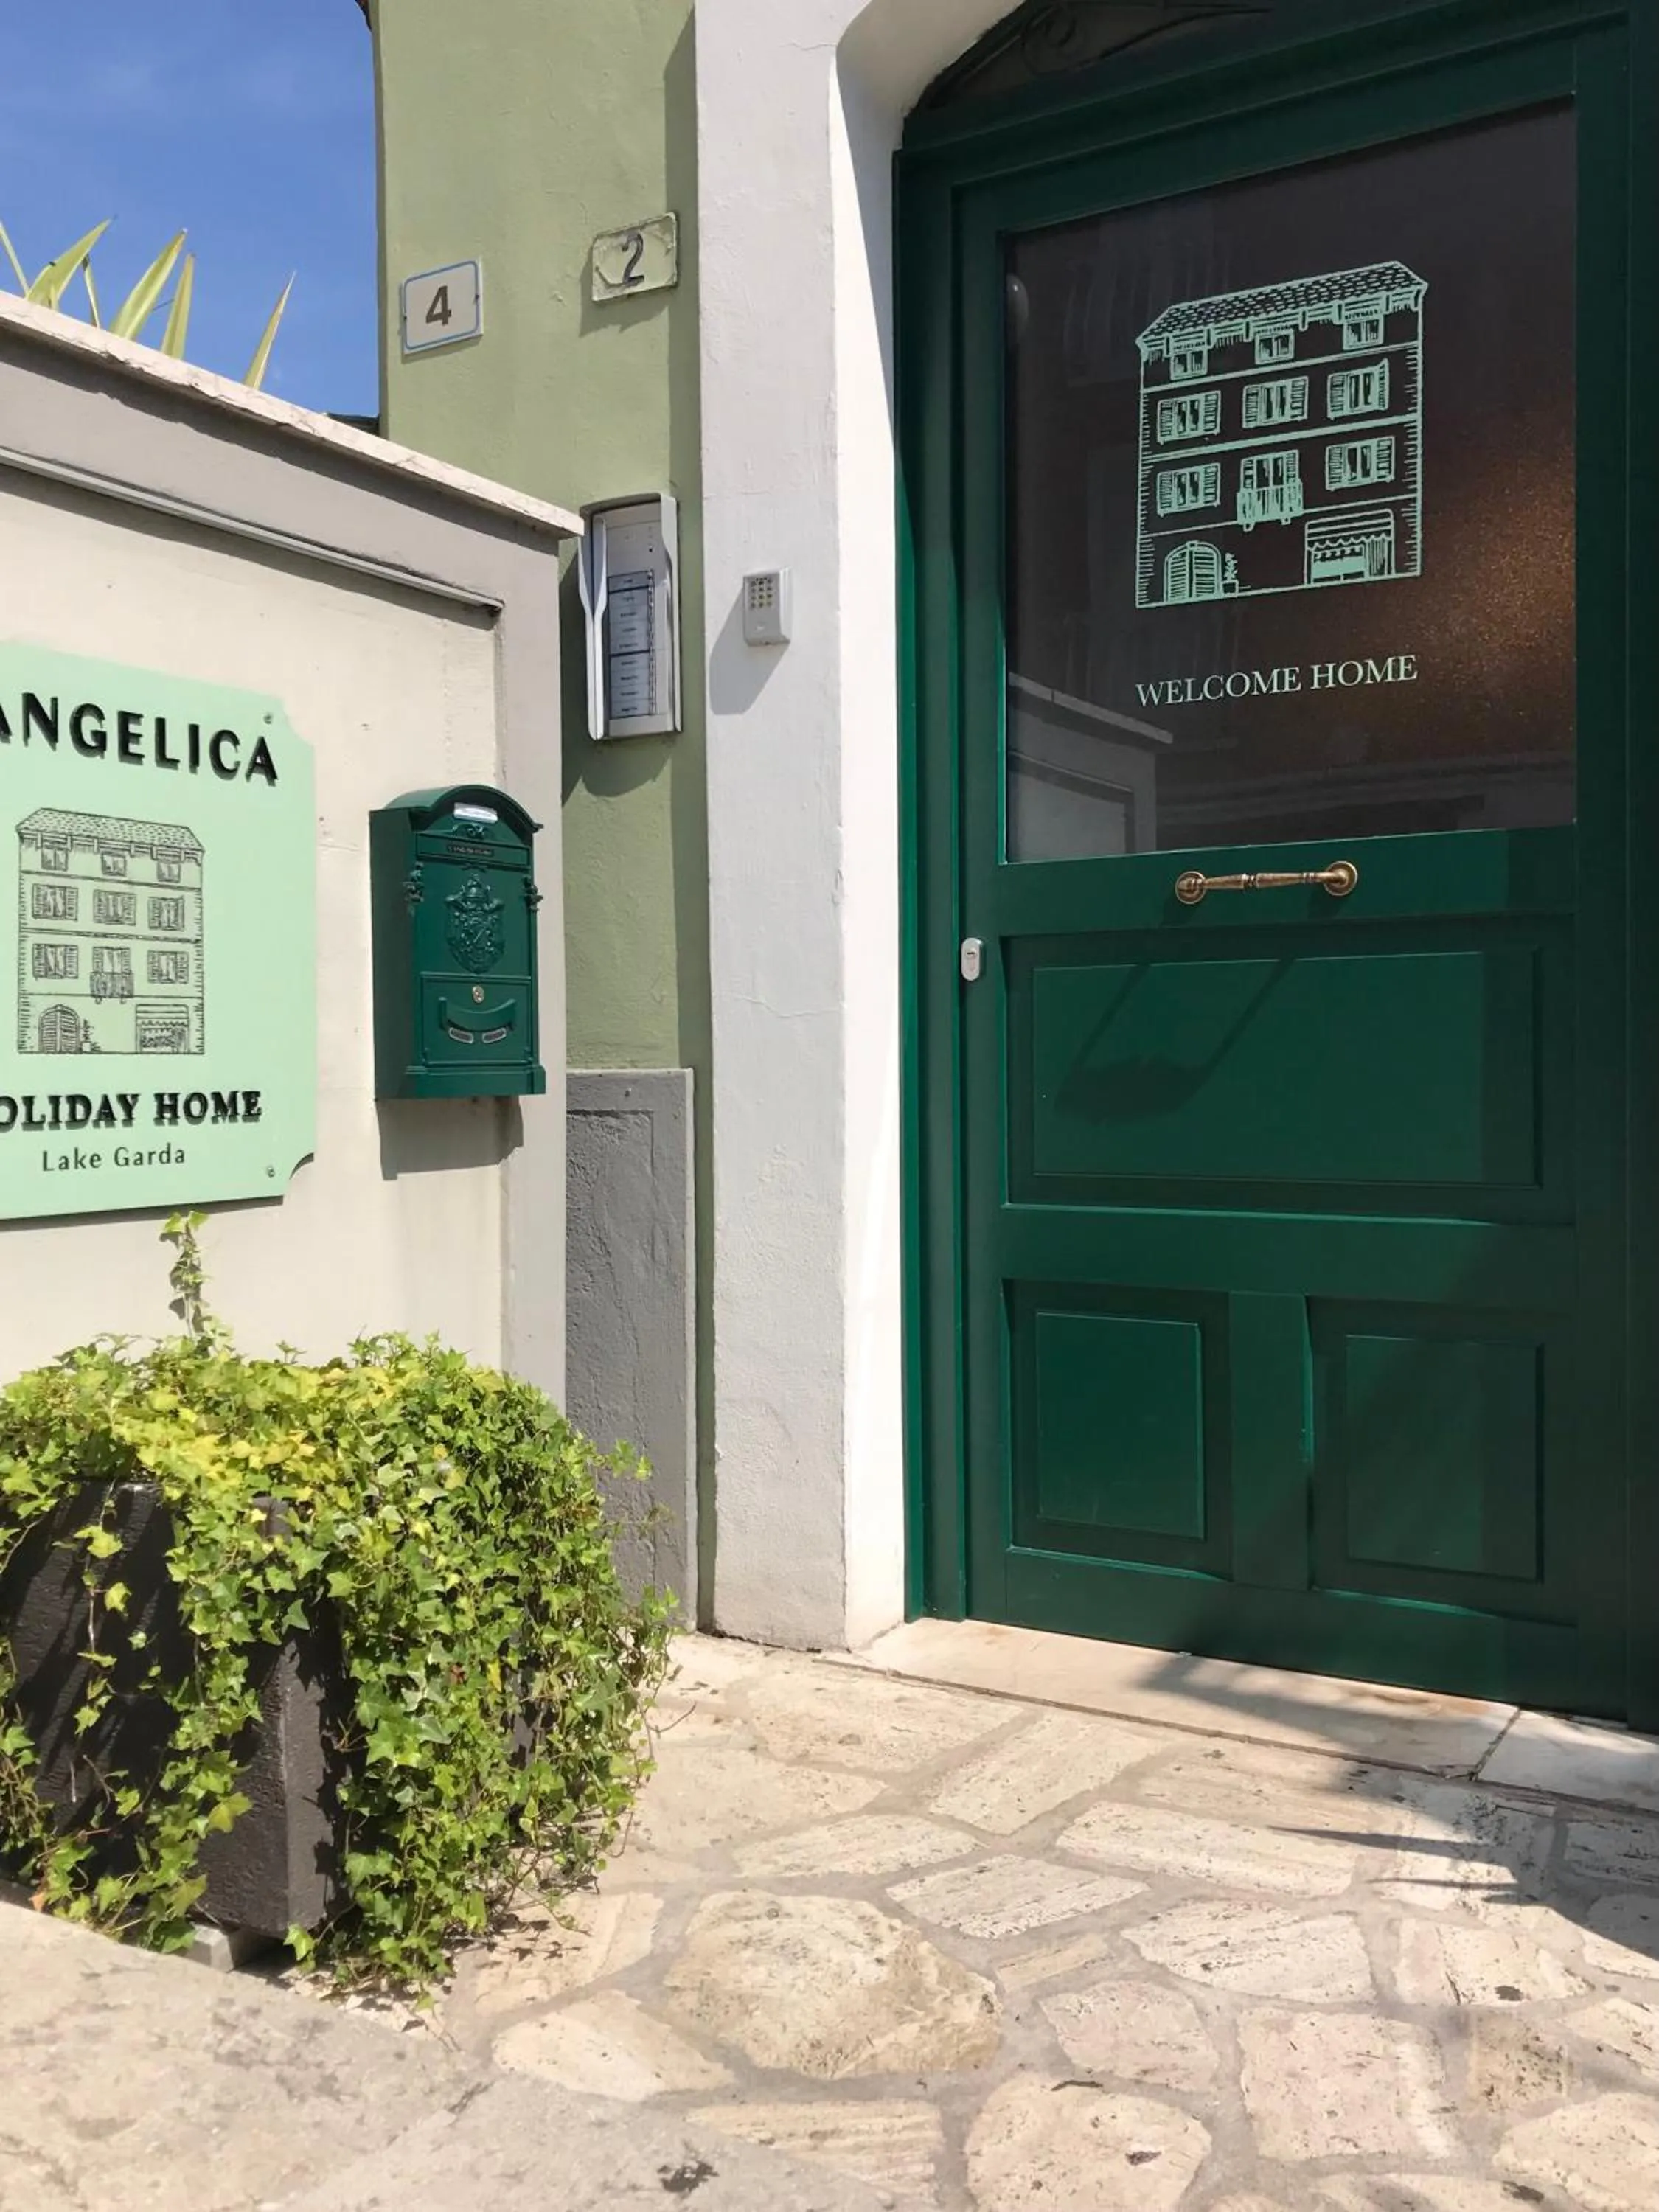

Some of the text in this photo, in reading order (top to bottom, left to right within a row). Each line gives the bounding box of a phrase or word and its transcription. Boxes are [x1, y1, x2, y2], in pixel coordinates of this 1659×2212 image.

[622, 232, 645, 287] 2
[425, 285, 452, 325] 4
[1135, 655, 1419, 706] WELCOME HOME
[153, 1091, 262, 1125] HOME
[42, 1142, 185, 1172] Lake Garda
